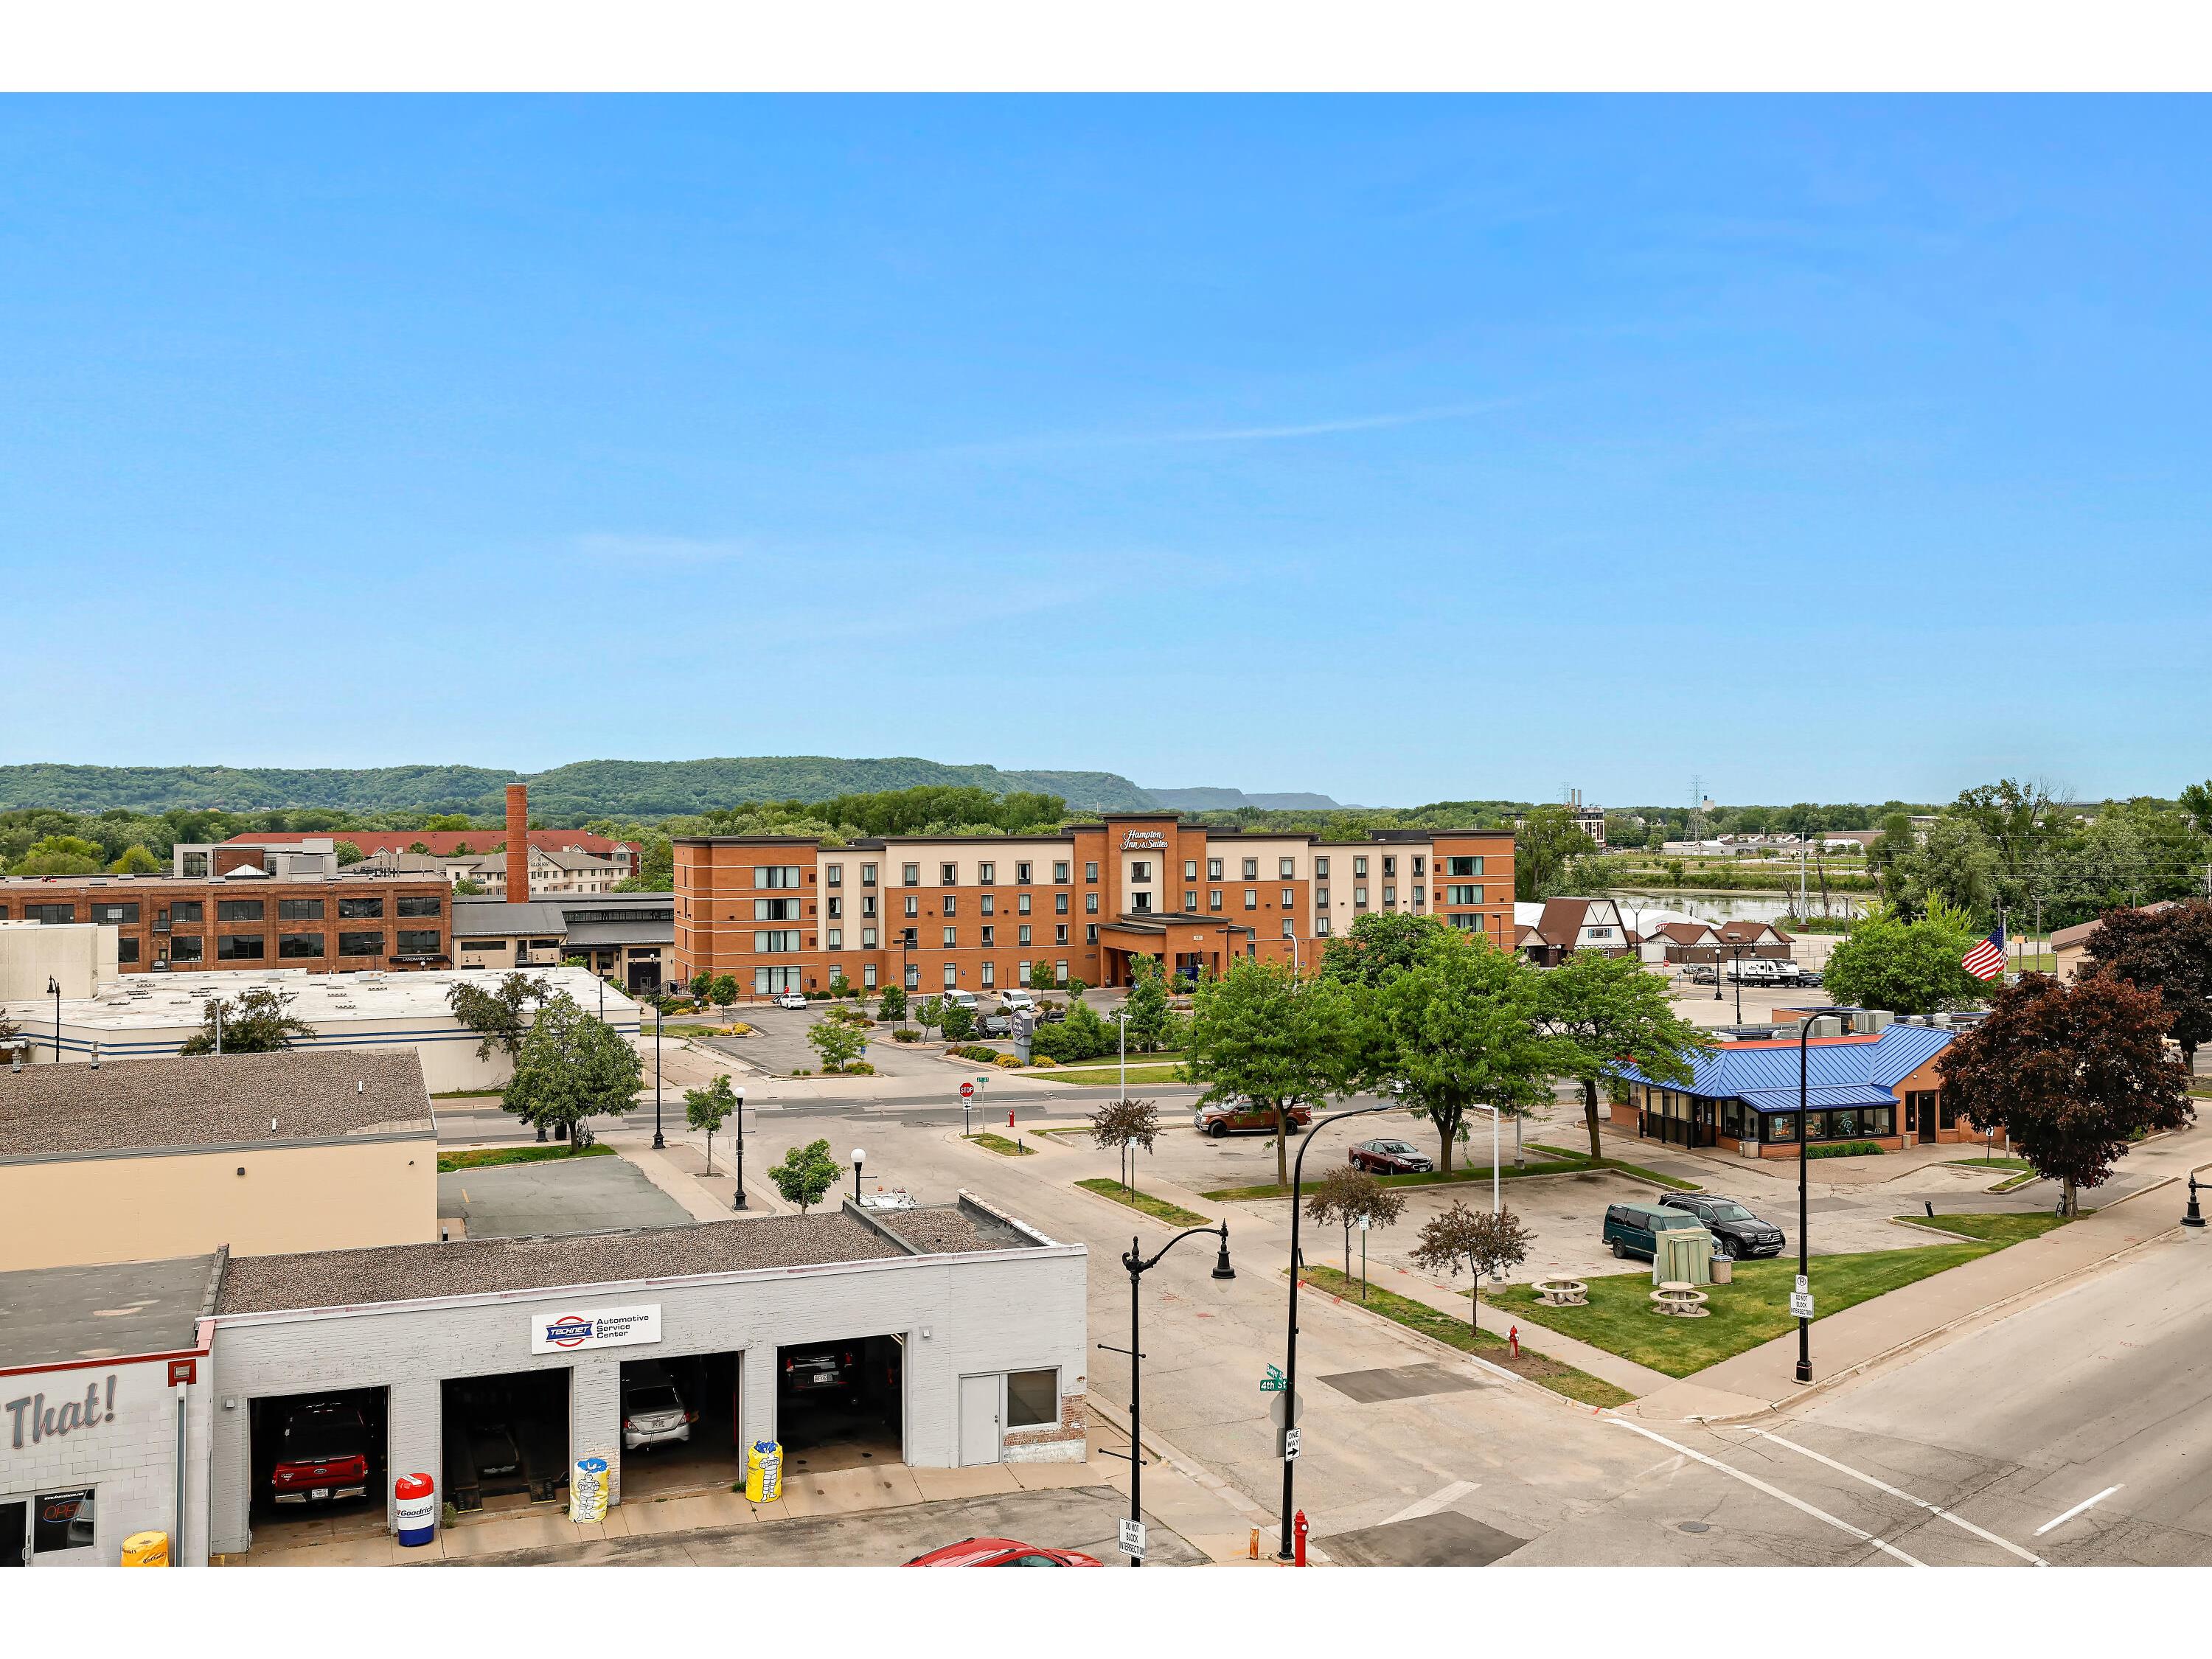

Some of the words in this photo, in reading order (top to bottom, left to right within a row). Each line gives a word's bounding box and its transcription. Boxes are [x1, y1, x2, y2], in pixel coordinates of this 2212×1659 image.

[1123, 830, 1165, 840] Hampton
[1120, 840, 1141, 849] Inn
[1145, 839, 1168, 849] Suites
[1791, 1308, 1812, 1316] INTERSECTION
[597, 1315, 649, 1325] Automotive
[597, 1324, 630, 1332] Service
[1261, 1381, 1274, 1390] 4th
[1278, 1380, 1287, 1389] St
[6, 1374, 116, 1449] That!
[1289, 1431, 1298, 1439] ONE
[1288, 1439, 1298, 1447] WAY
[1126, 1522, 1130, 1530] DO
[1127, 1532, 1138, 1543] BLOCK
[1120, 1541, 1144, 1555] INTERSECTION
